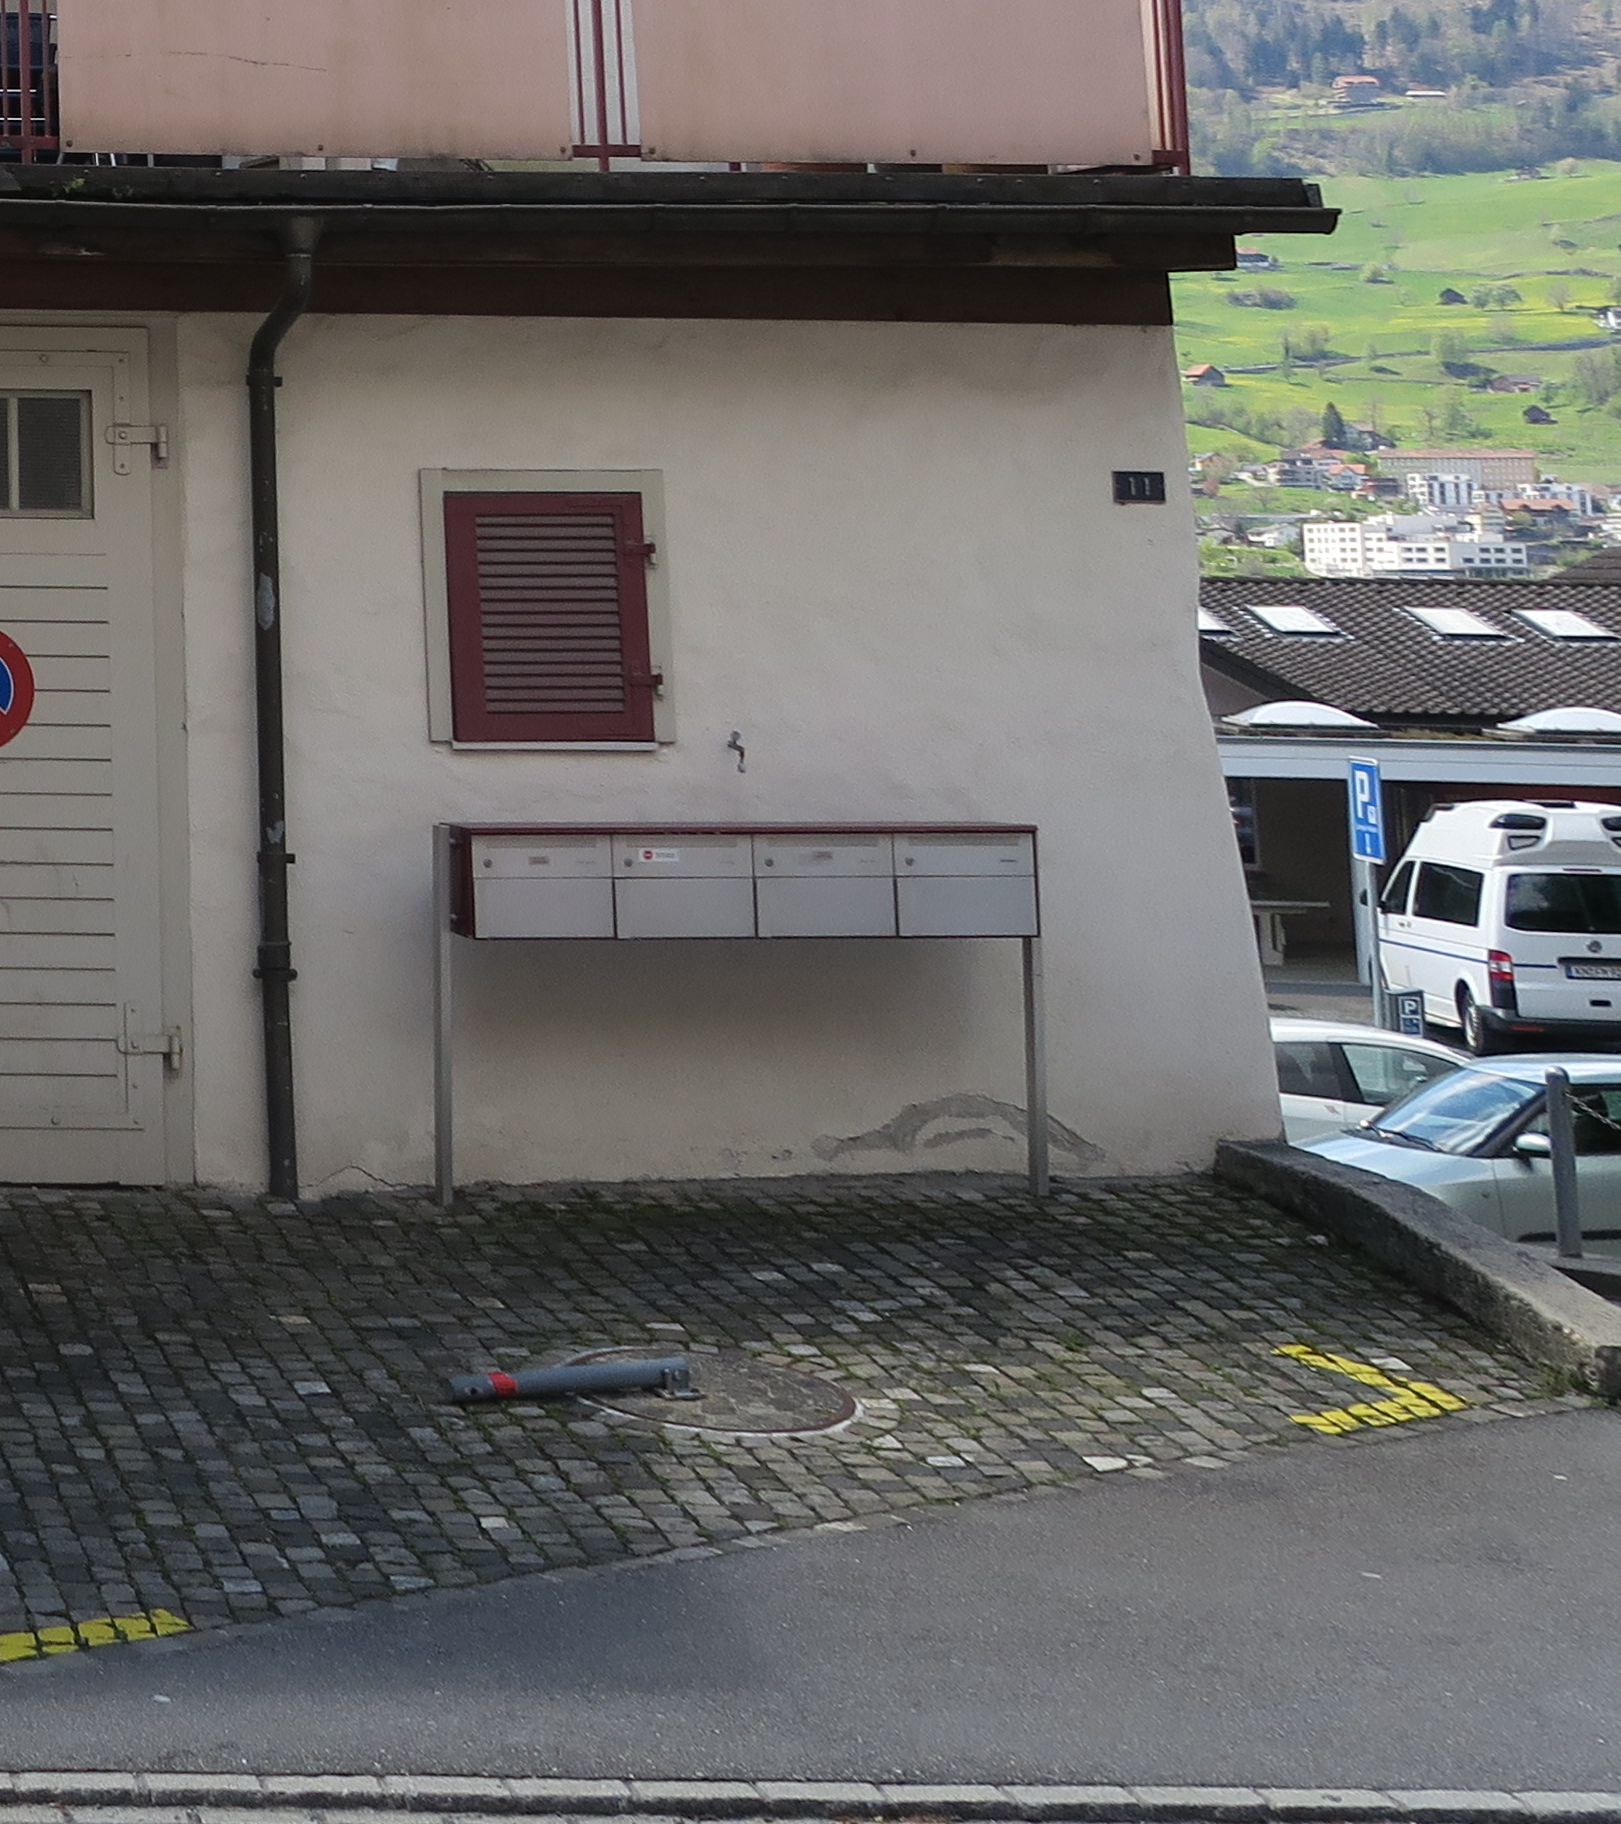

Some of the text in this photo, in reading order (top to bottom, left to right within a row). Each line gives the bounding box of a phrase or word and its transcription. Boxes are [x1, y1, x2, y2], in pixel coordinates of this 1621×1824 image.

[1127, 476, 1150, 496] 11
[1355, 770, 1370, 819] P
[1404, 1000, 1417, 1015] P
